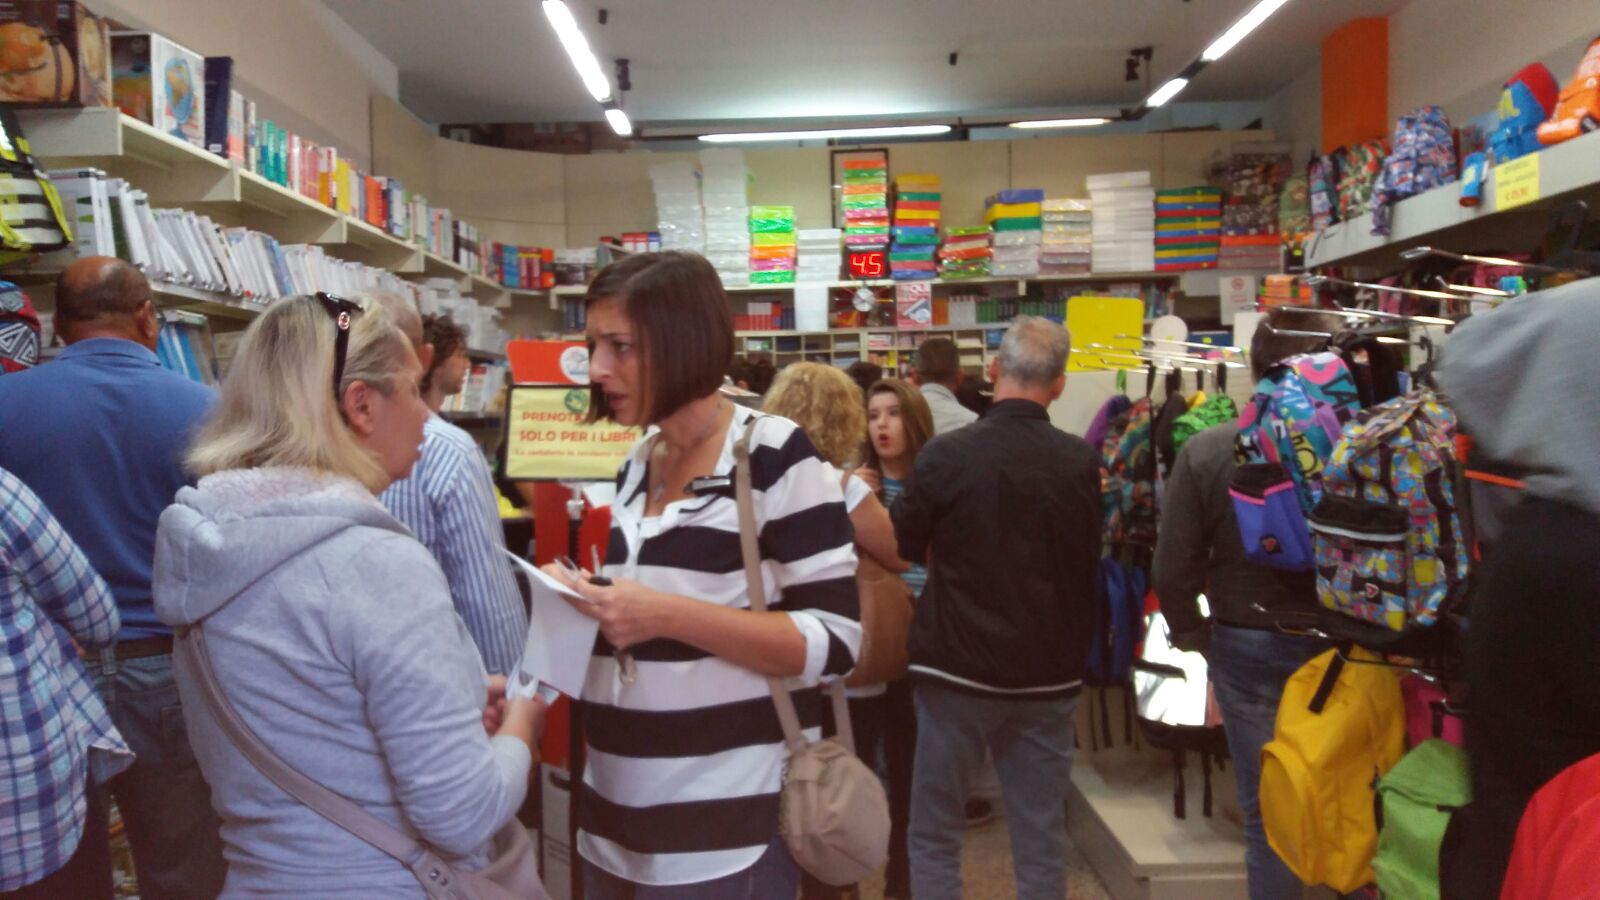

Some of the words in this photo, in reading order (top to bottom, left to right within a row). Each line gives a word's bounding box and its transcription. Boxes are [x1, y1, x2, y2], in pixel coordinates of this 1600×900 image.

[852, 253, 882, 275] 45
[519, 430, 557, 442] SOLO
[560, 431, 588, 442] PER
[600, 431, 637, 443] LIBRI
